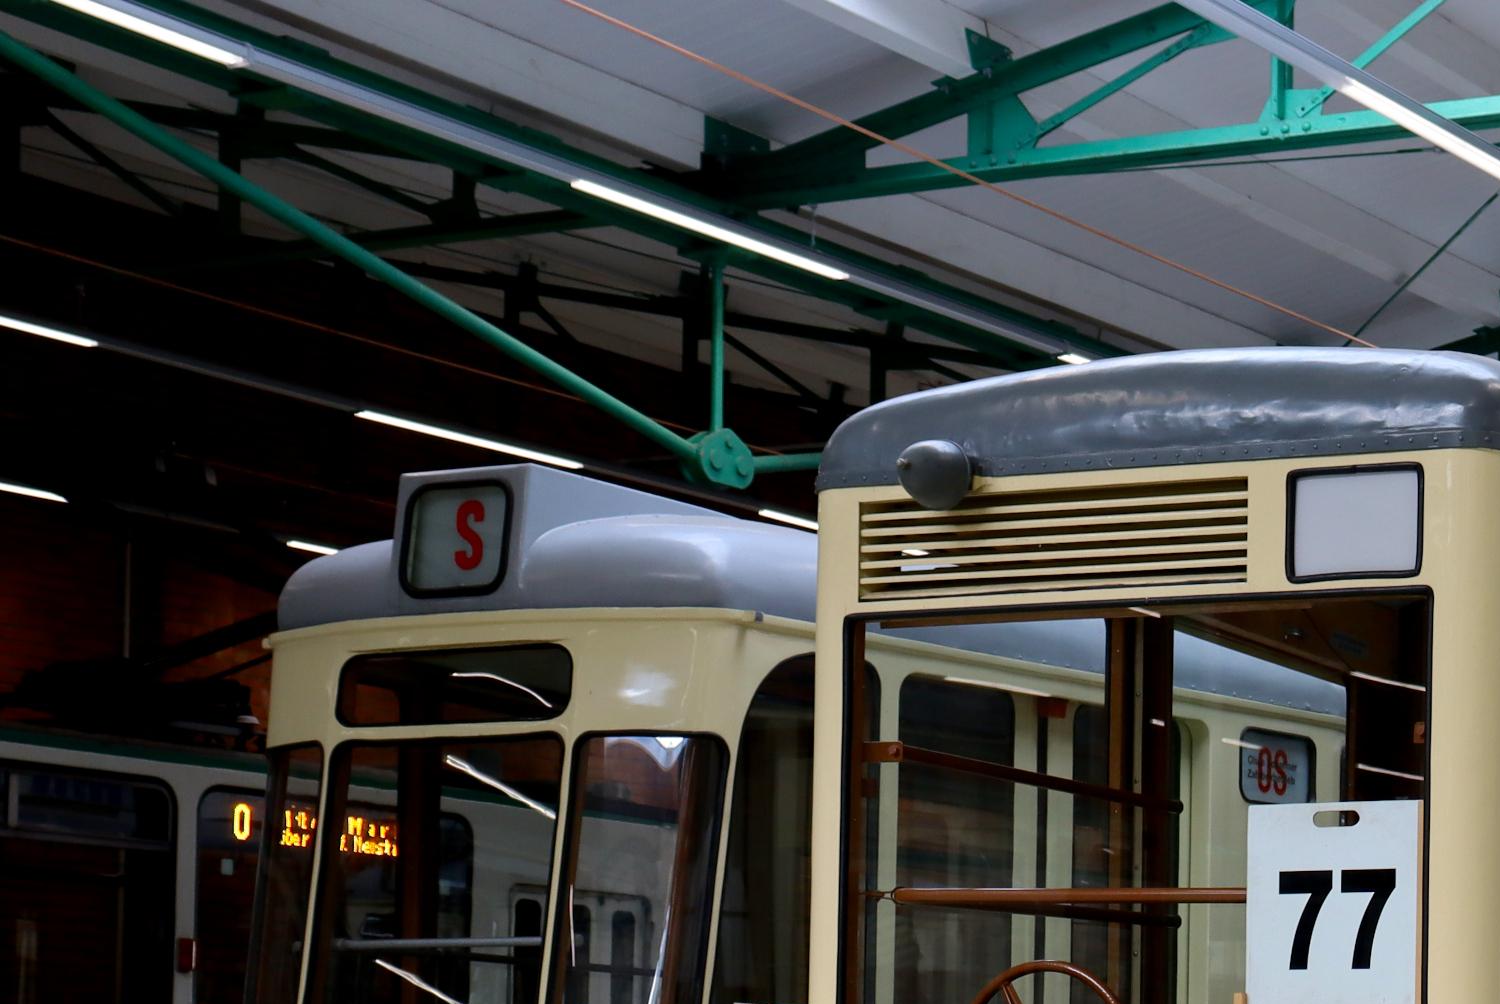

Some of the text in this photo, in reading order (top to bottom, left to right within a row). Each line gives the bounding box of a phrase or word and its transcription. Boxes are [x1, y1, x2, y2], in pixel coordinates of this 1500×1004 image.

[454, 499, 485, 571] S
[1258, 746, 1288, 796] OS
[1279, 868, 1396, 970] 77
